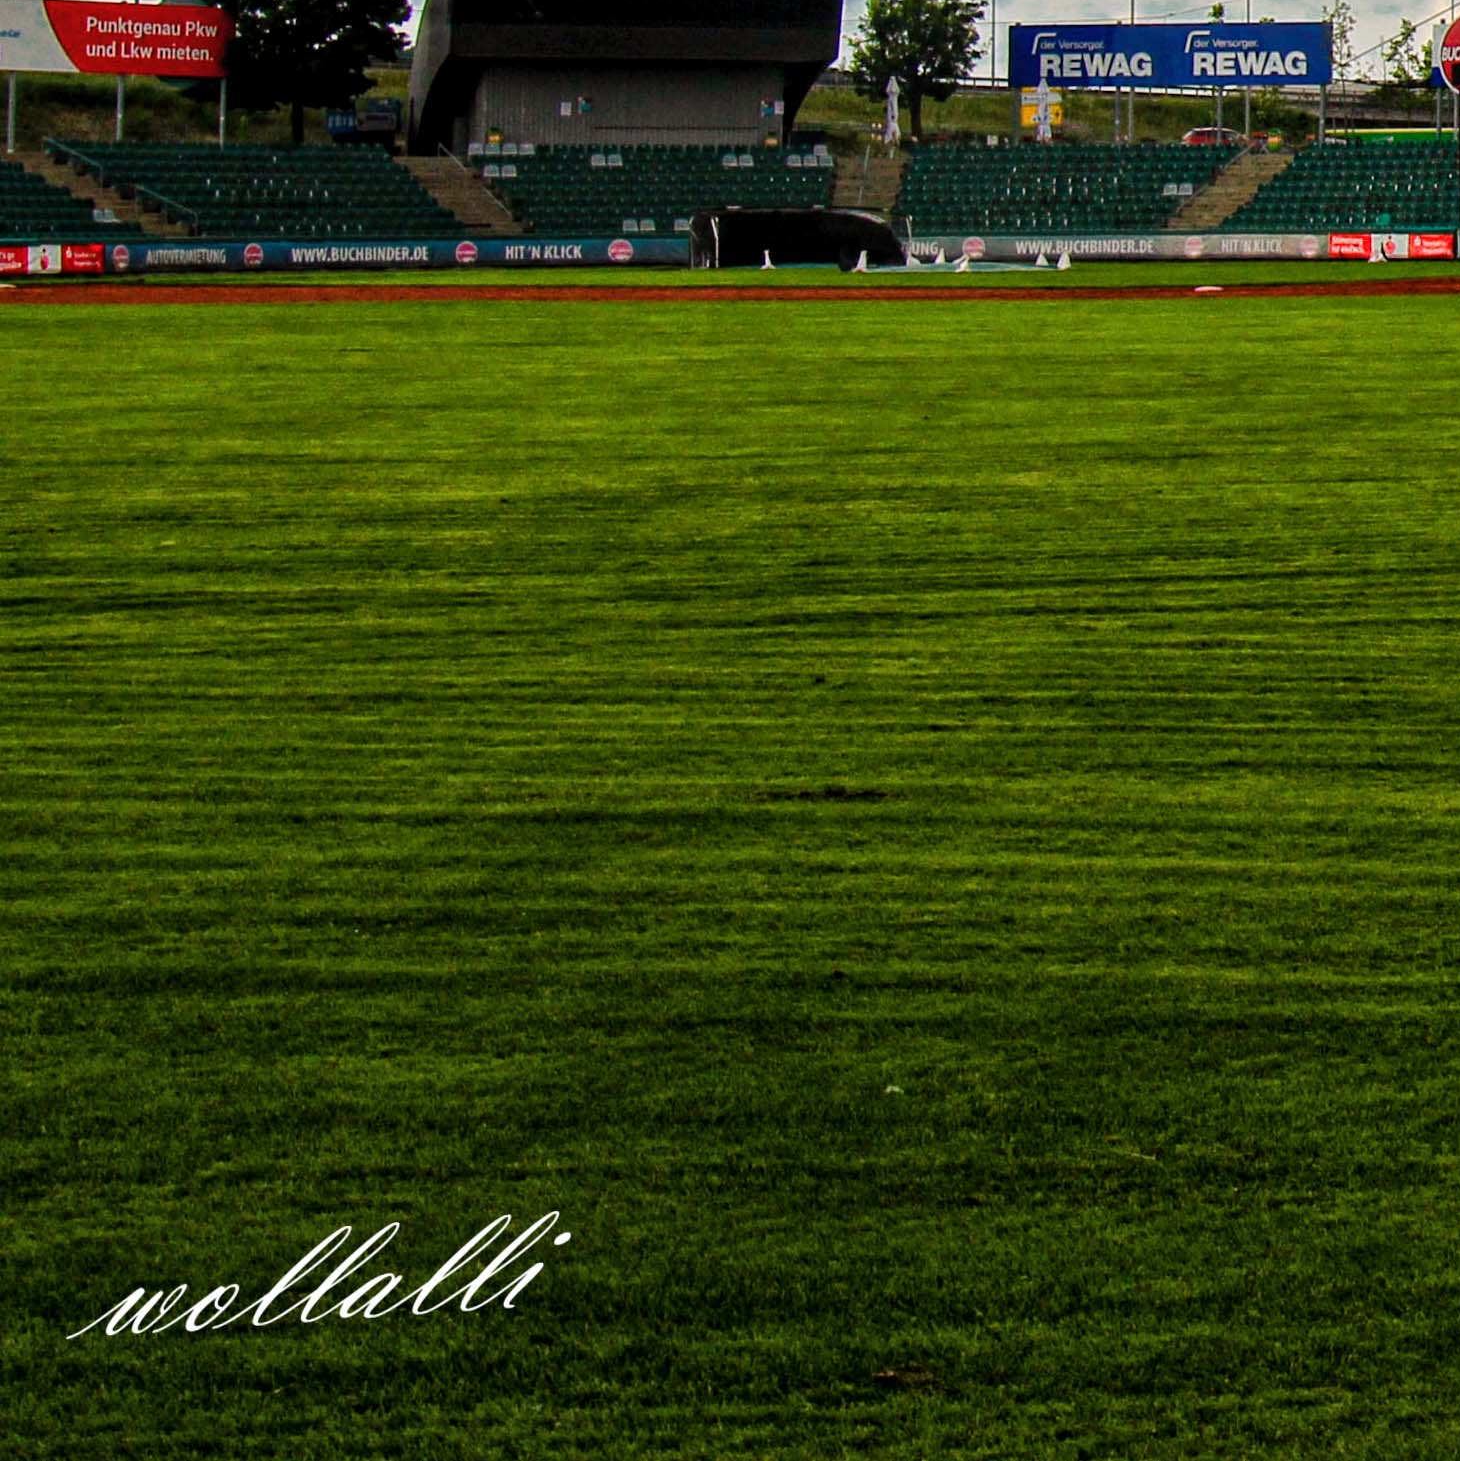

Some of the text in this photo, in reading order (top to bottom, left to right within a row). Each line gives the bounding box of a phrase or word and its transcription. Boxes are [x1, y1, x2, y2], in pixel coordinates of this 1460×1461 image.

[86, 17, 218, 39] Punktgenau Pkw
[86, 42, 214, 62] und Lkw mieten.
[1040, 39, 1056, 50] der
[1193, 39, 1209, 49] der
[1040, 52, 1153, 78] REWAG
[1192, 51, 1307, 76] REWAG
[291, 246, 429, 263] WWW.BUCHBINDER.DE
[505, 245, 524, 260] HIT
[544, 245, 582, 260] KLICK
[1016, 240, 1154, 254] WWW.BUCHBINDER.DE
[145, 248, 226, 265] AUTOVERMIETUNG
